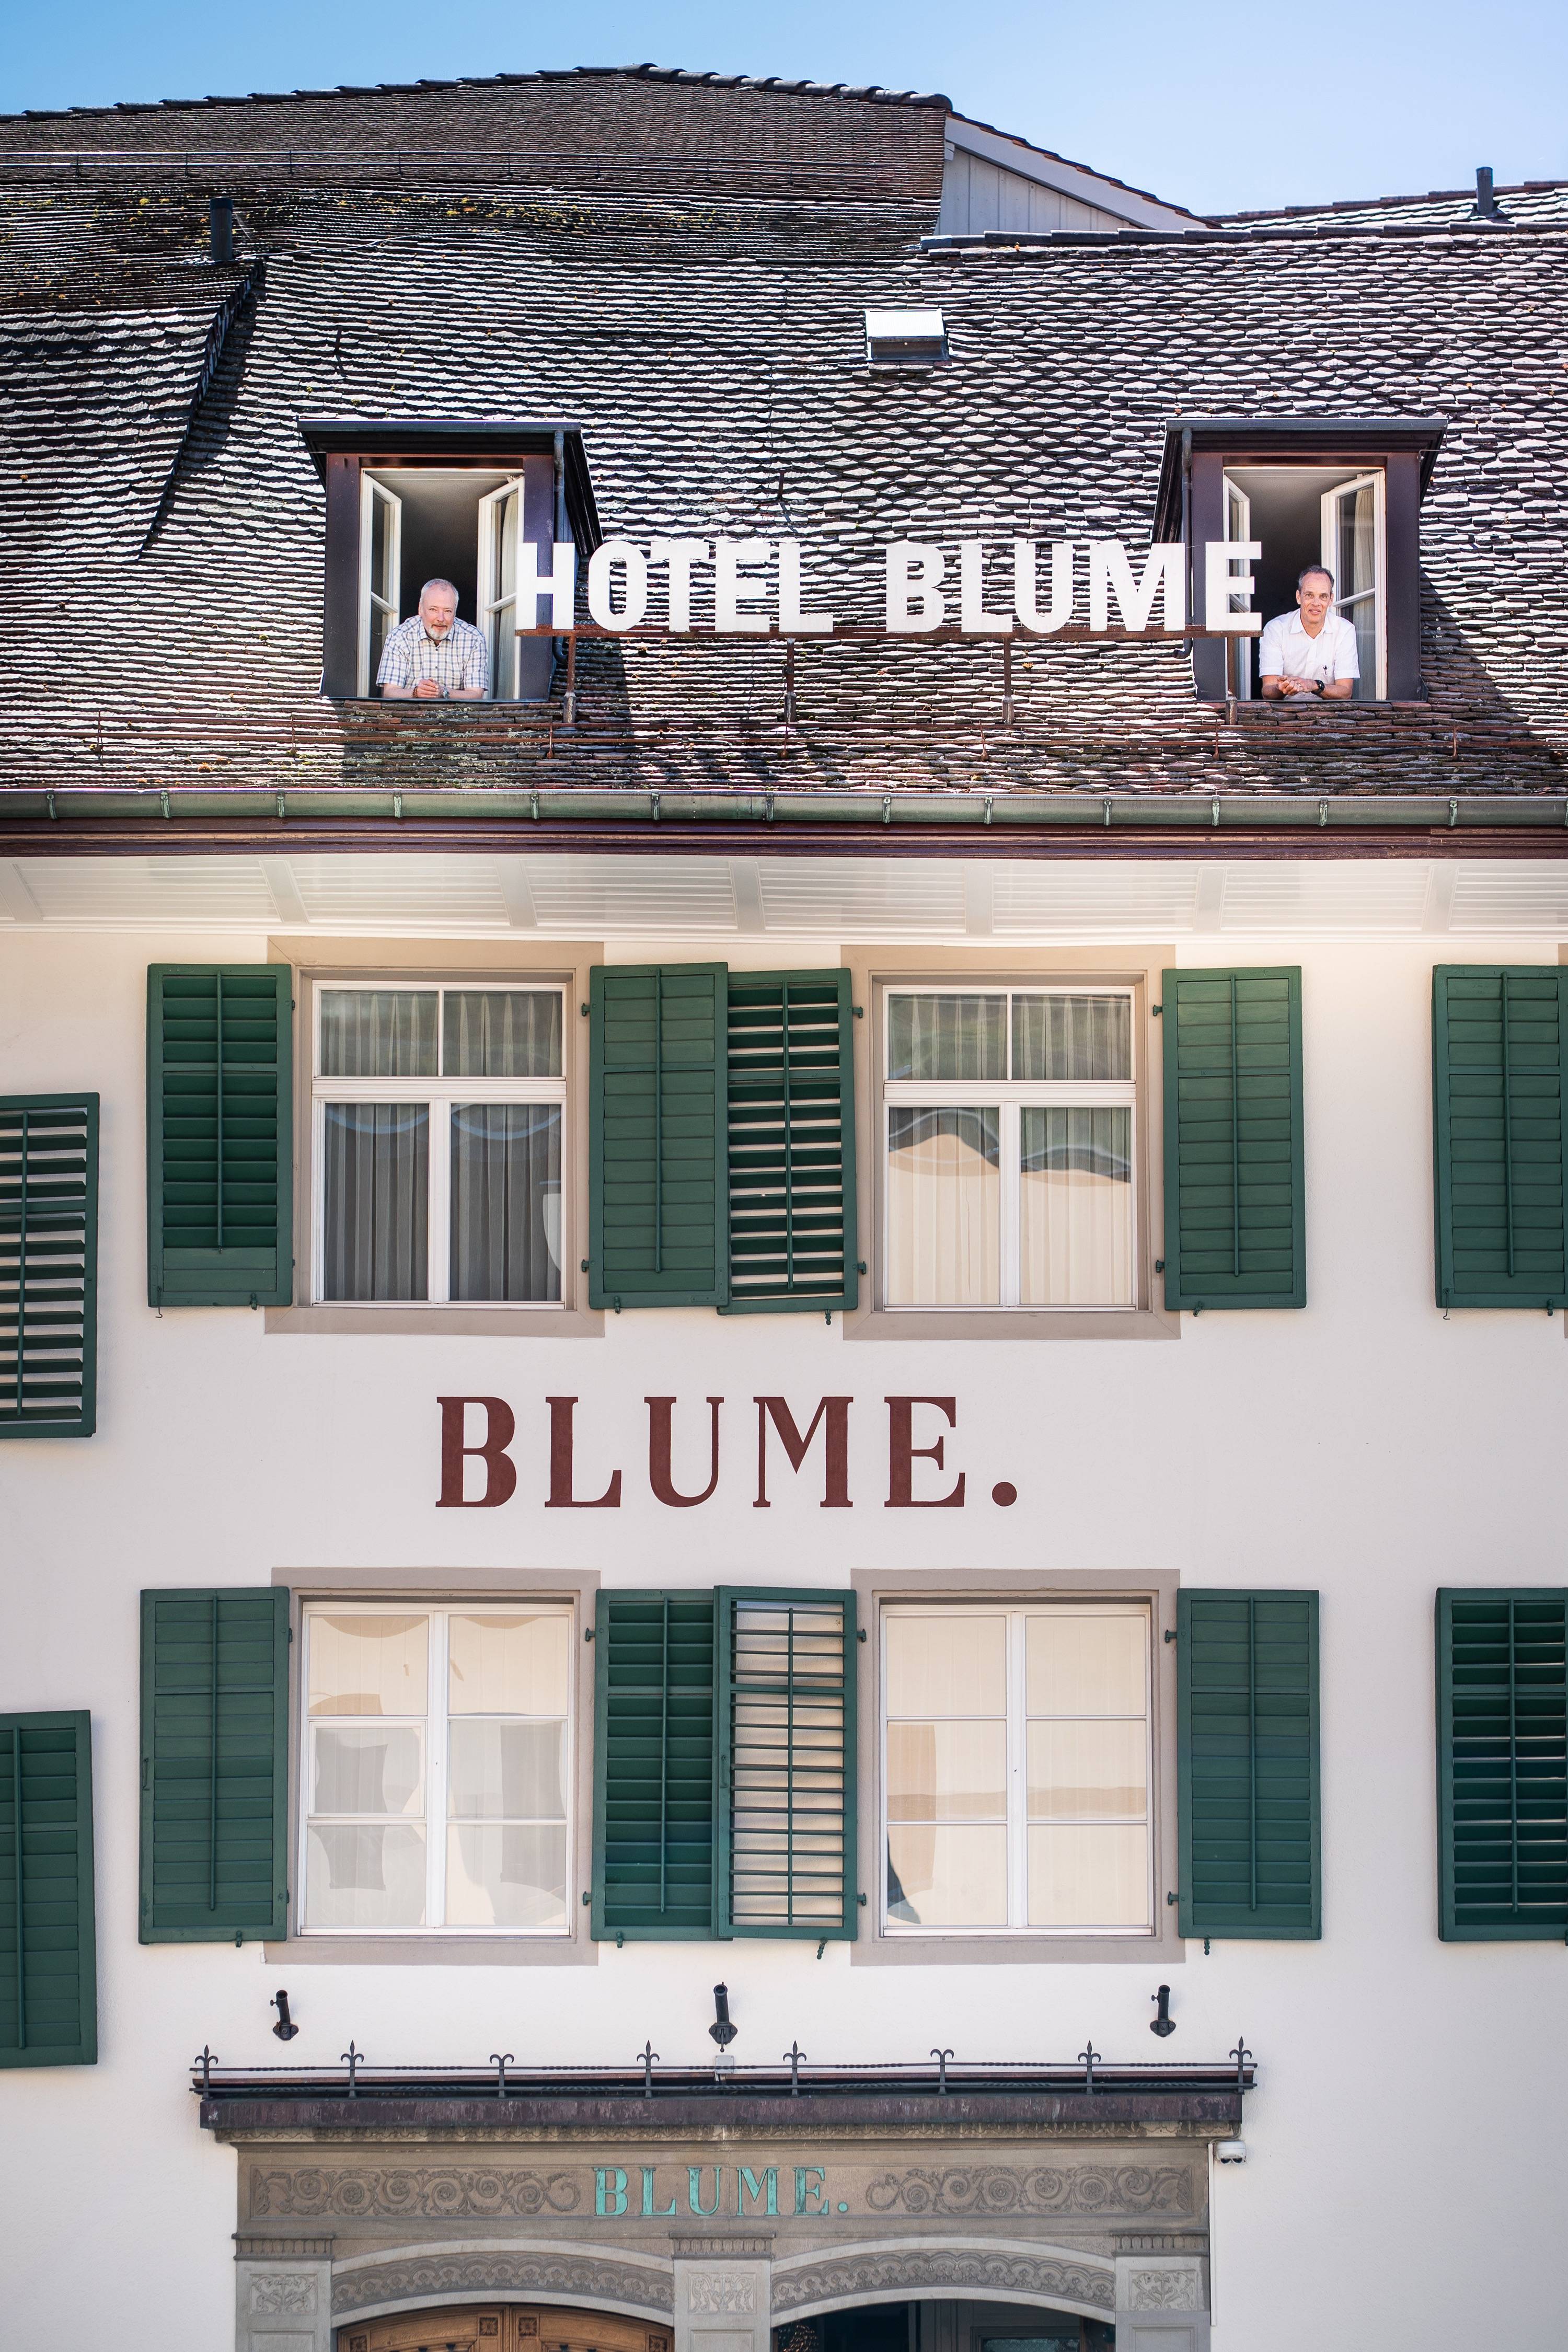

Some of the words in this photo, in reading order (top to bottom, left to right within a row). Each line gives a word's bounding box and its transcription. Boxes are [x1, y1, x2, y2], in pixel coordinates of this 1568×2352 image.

[516, 541, 834, 631] HOTEL
[886, 541, 1262, 631] BLUME
[435, 1396, 1017, 1508] BLUME.
[594, 2167, 848, 2217] BLUME.
